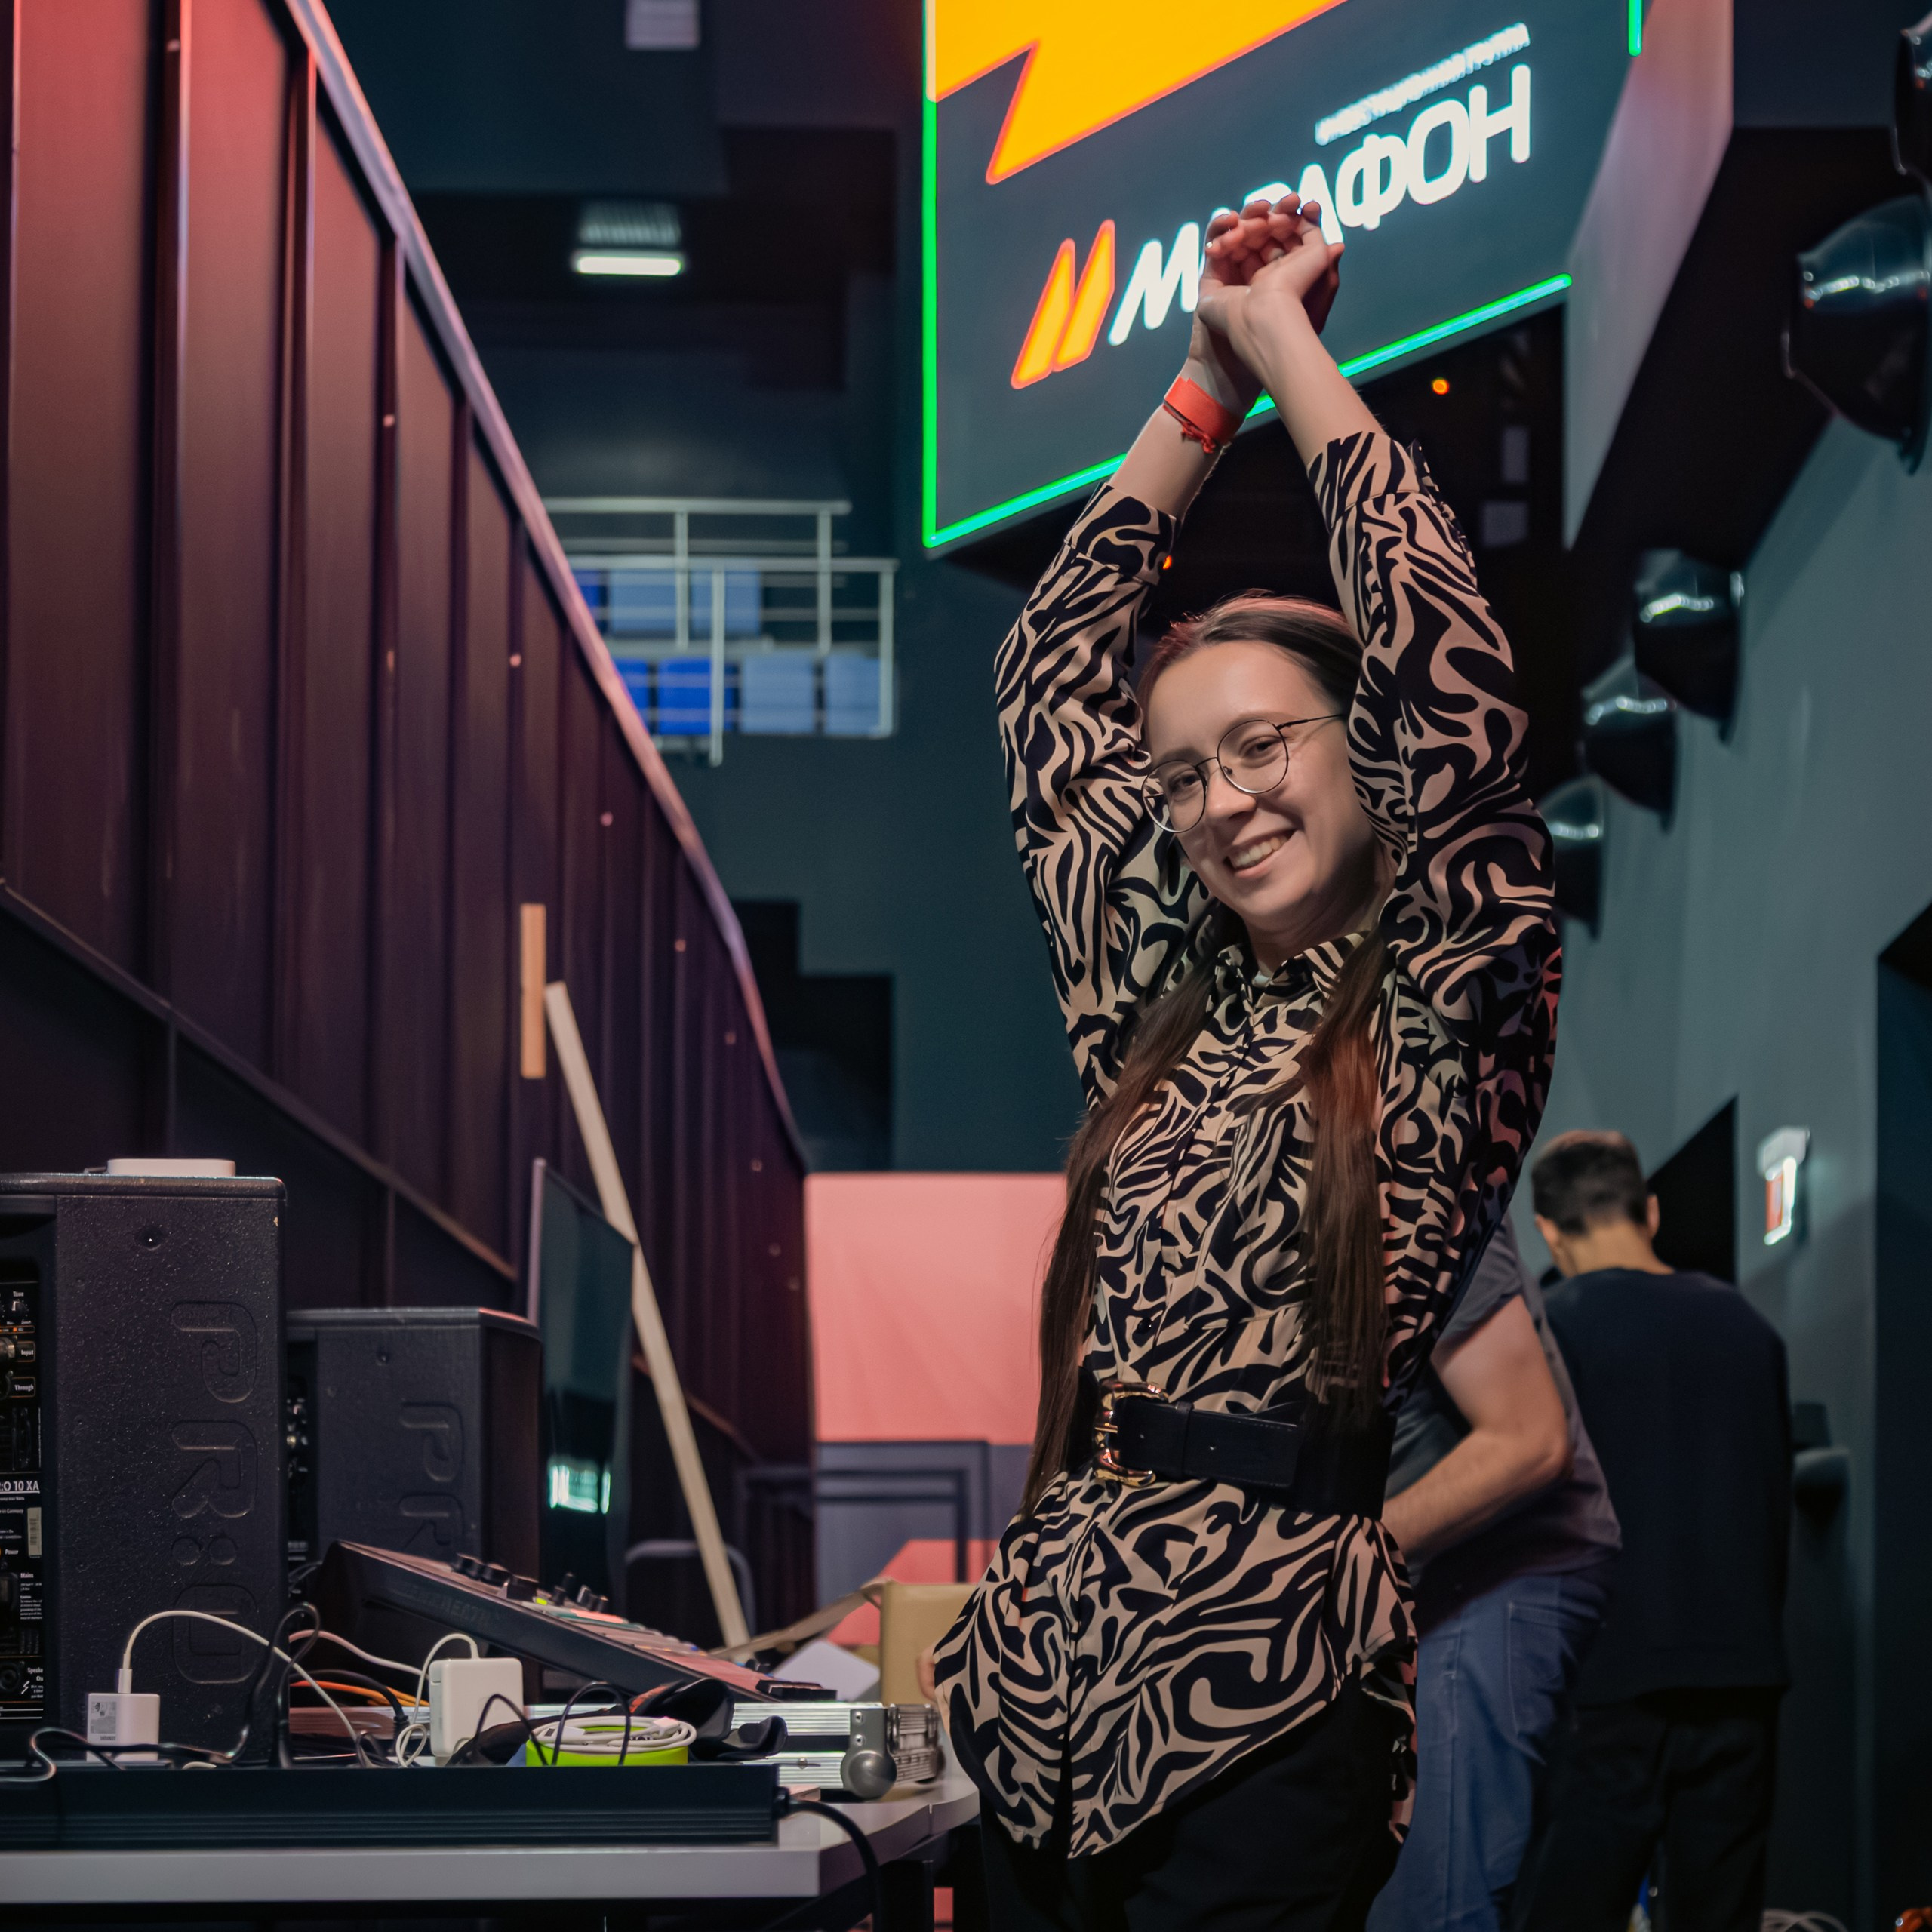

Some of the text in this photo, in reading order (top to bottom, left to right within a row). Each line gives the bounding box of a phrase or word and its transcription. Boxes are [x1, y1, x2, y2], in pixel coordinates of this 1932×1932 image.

[1109, 63, 1531, 346] МАФОН
[13, 1480, 24, 1491] 10
[26, 1480, 39, 1491] XA
